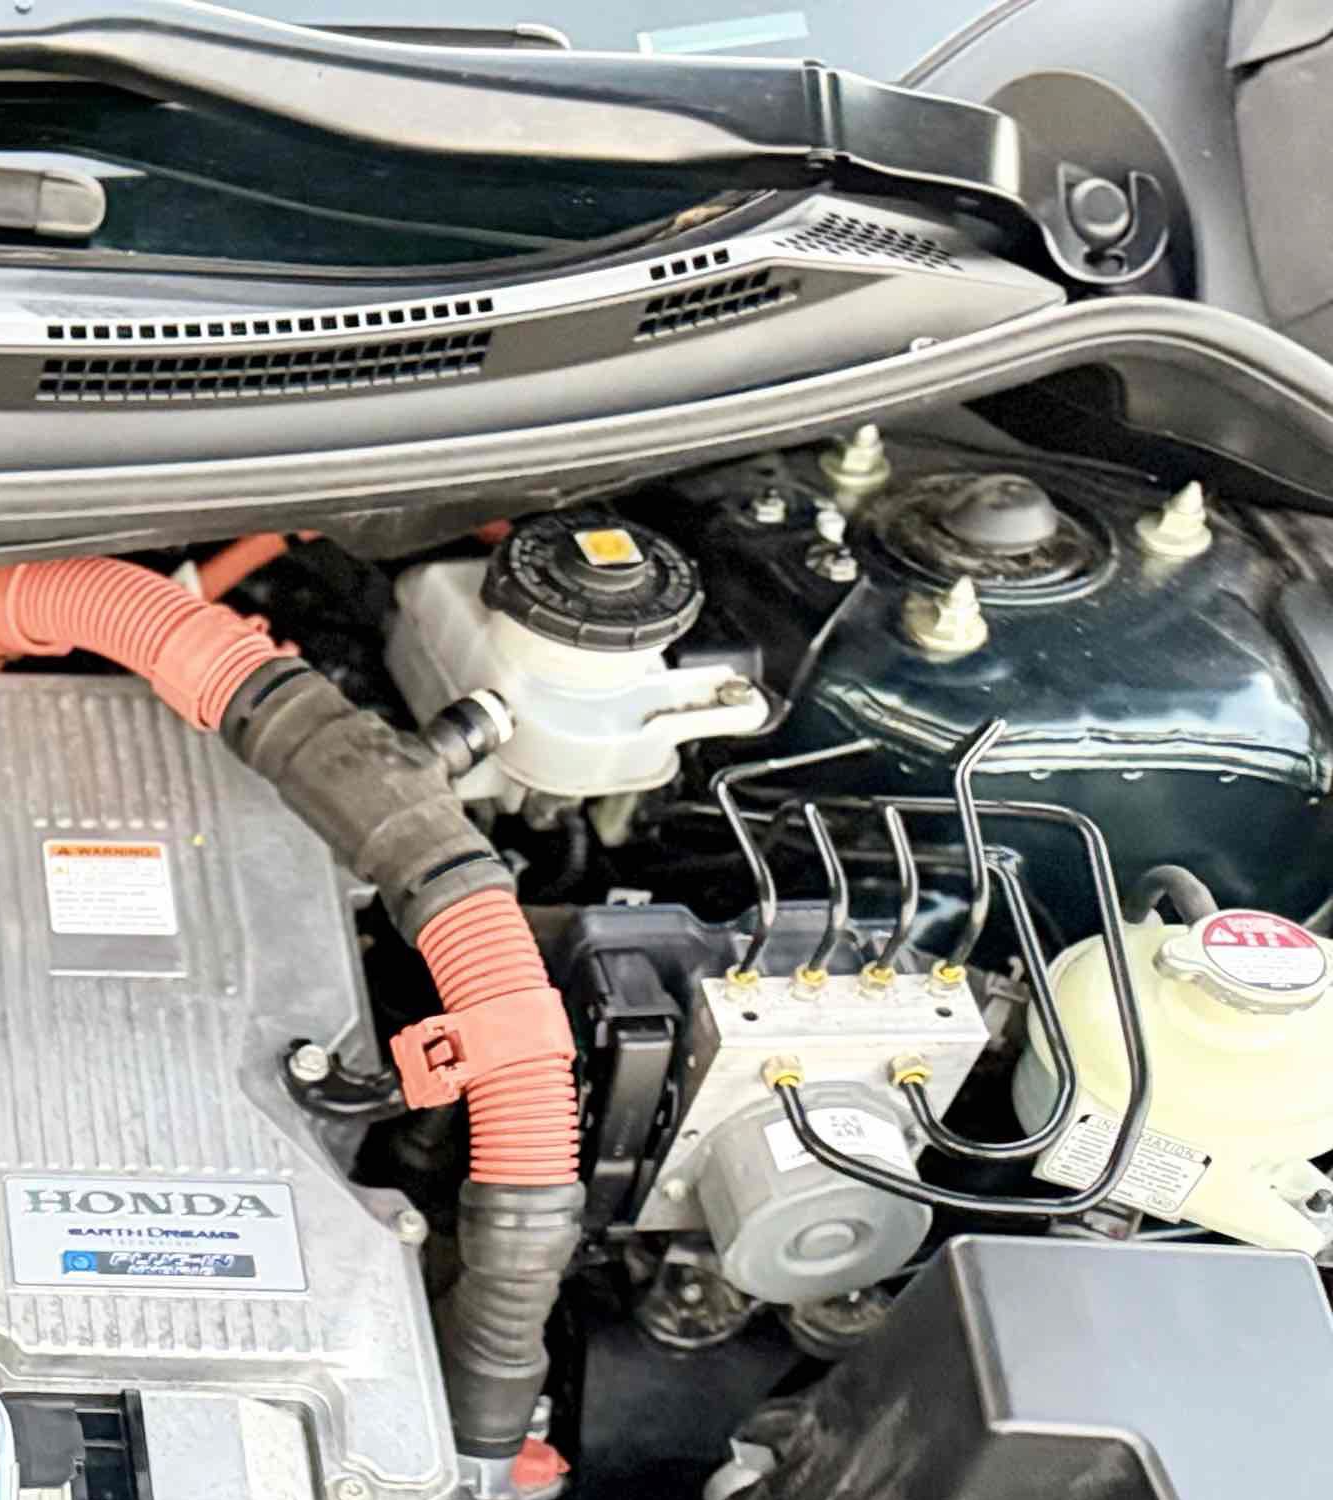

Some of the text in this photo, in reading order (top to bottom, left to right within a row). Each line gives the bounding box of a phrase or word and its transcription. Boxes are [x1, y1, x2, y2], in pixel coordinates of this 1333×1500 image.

[24, 1189, 281, 1218] HONDA
[68, 1226, 240, 1240] EARTH DREAMS
